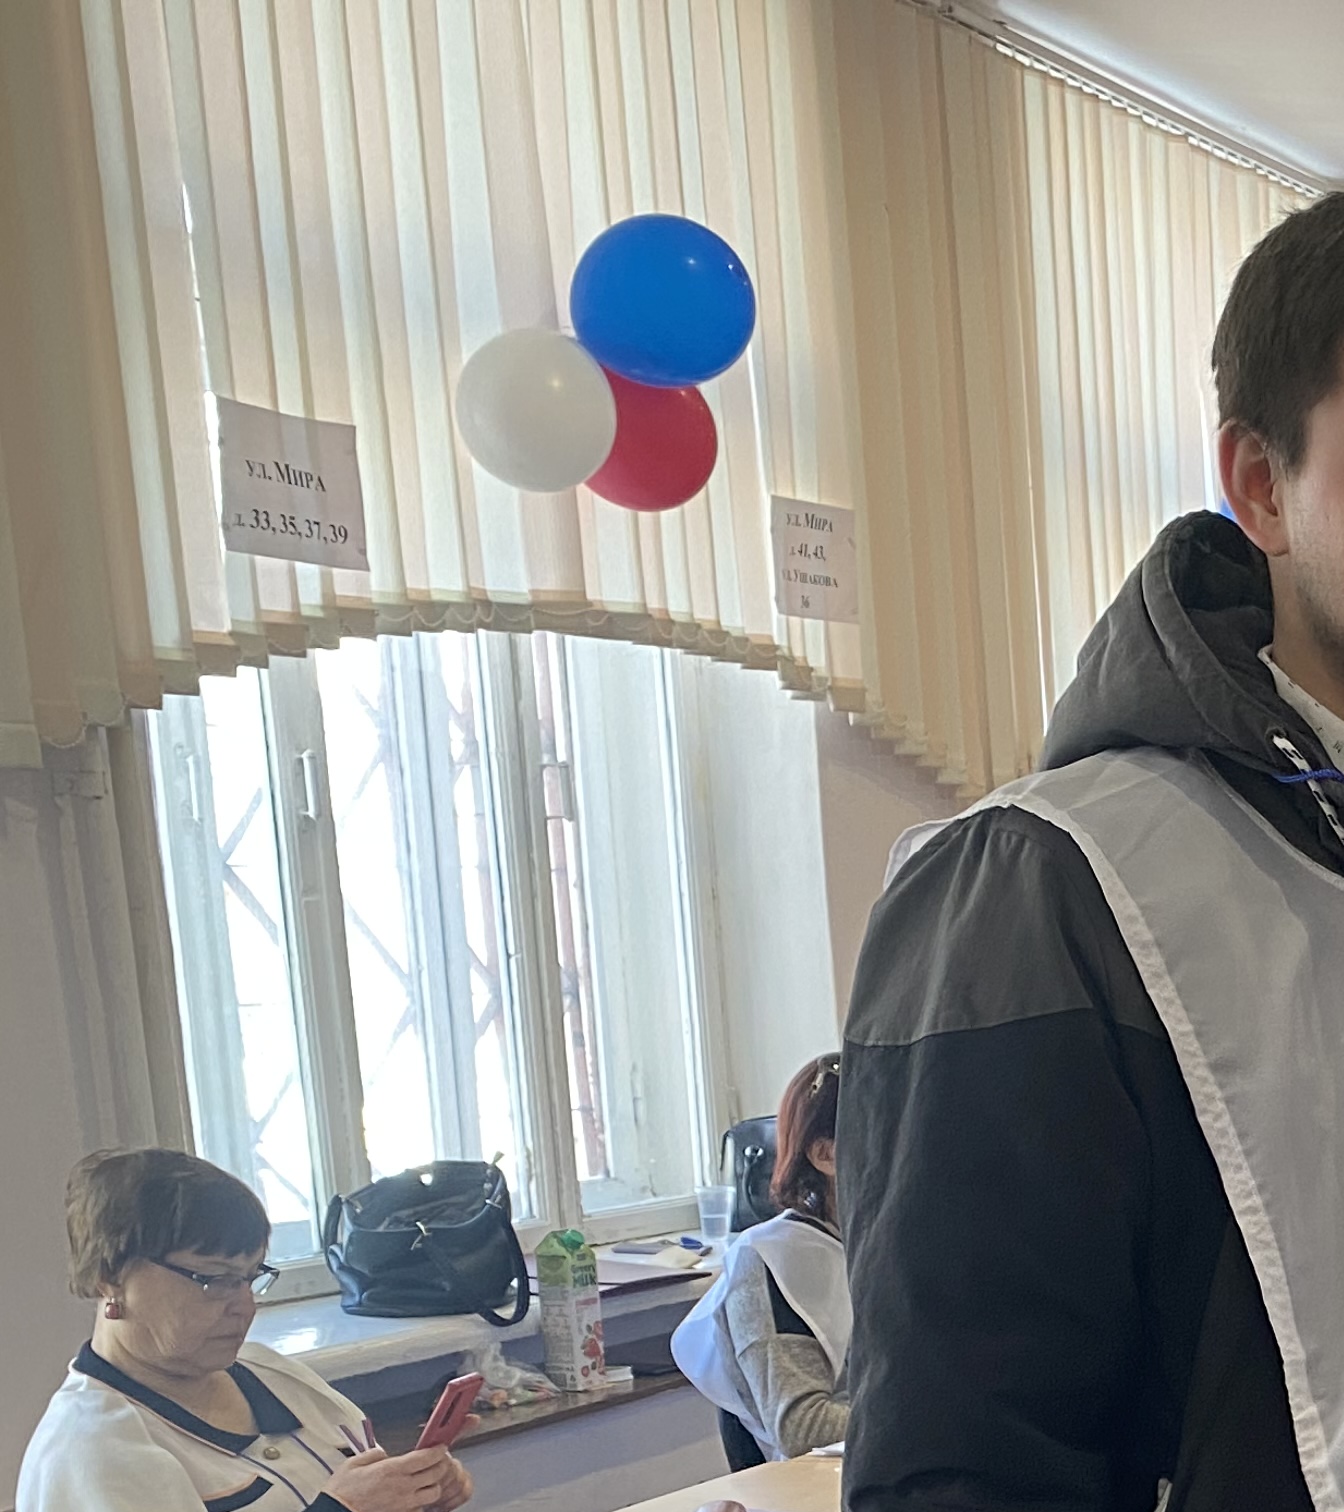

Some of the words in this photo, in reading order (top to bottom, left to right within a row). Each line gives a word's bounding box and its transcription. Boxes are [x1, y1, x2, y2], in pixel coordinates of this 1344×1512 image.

[250, 508, 277, 535] 33,
[280, 513, 302, 539] 35,
[304, 519, 327, 545] 37,
[328, 524, 348, 544] 39
